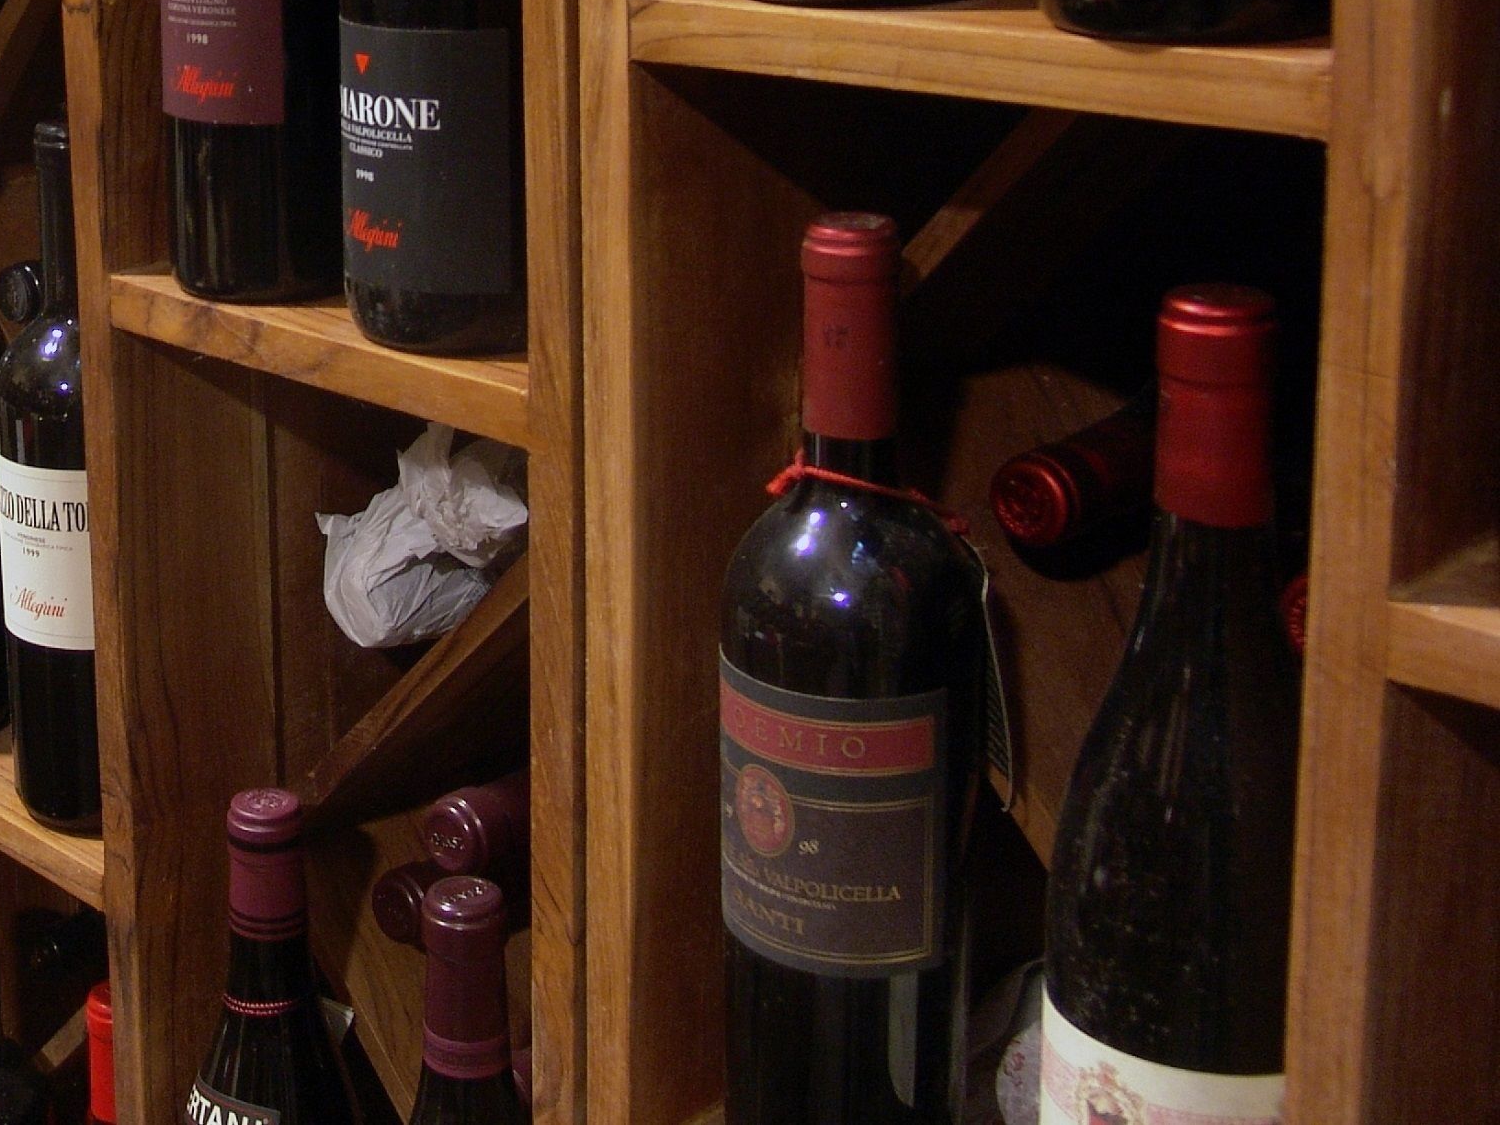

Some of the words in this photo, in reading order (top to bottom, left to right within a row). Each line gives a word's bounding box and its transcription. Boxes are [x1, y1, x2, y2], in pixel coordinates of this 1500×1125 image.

[16, 493, 60, 532] DELLA
[62, 501, 89, 533] TO
[11, 585, 68, 620] Allegrini
